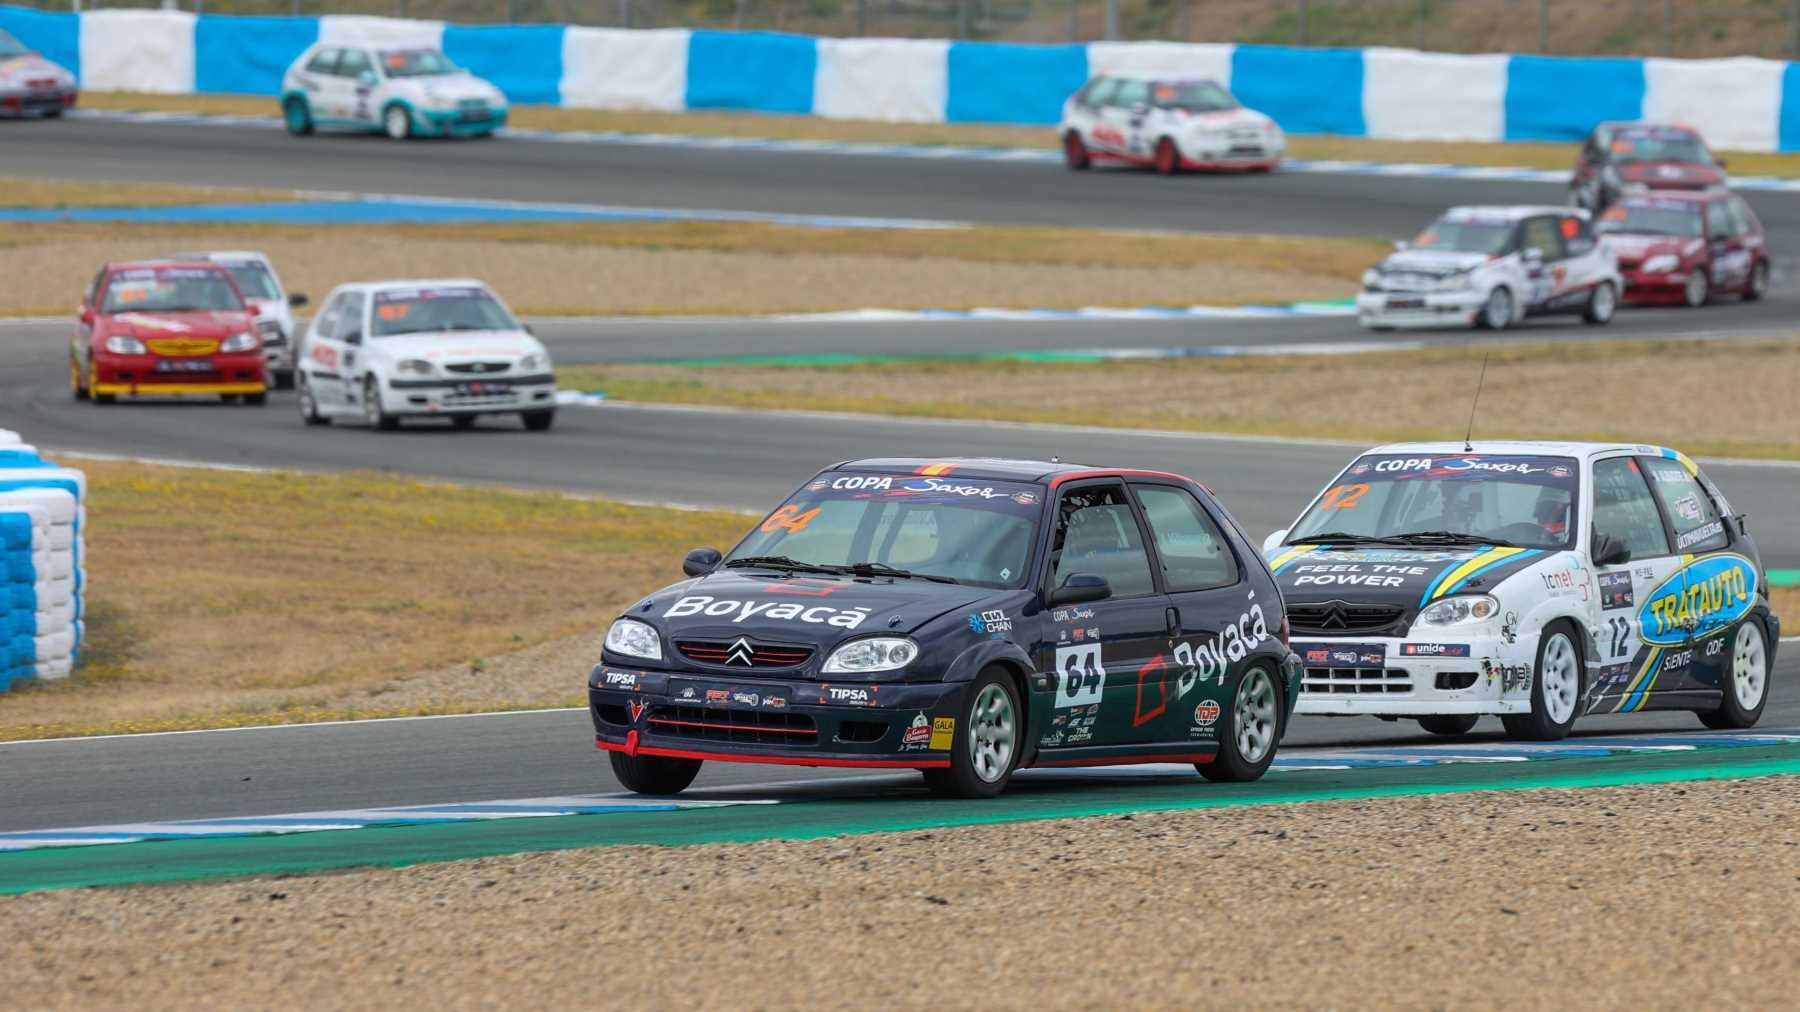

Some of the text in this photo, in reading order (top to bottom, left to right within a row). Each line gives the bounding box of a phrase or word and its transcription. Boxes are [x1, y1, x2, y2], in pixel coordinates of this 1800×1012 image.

[1375, 458, 1431, 472] COPA
[832, 477, 892, 490] COPA
[1321, 483, 1370, 510] 12
[761, 504, 822, 535] 64
[1295, 564, 1429, 575] FEEL THE
[1293, 575, 1404, 587] POWER
[1651, 566, 1746, 635] TRATAUTO
[662, 596, 872, 629] Boyacá
[1173, 590, 1267, 700] Boyacá
[1417, 641, 1446, 653] unide
[1608, 616, 1630, 658] 12
[606, 672, 635, 685] TIPSA
[1065, 652, 1100, 698] 64
[829, 688, 868, 700] TIPSA
